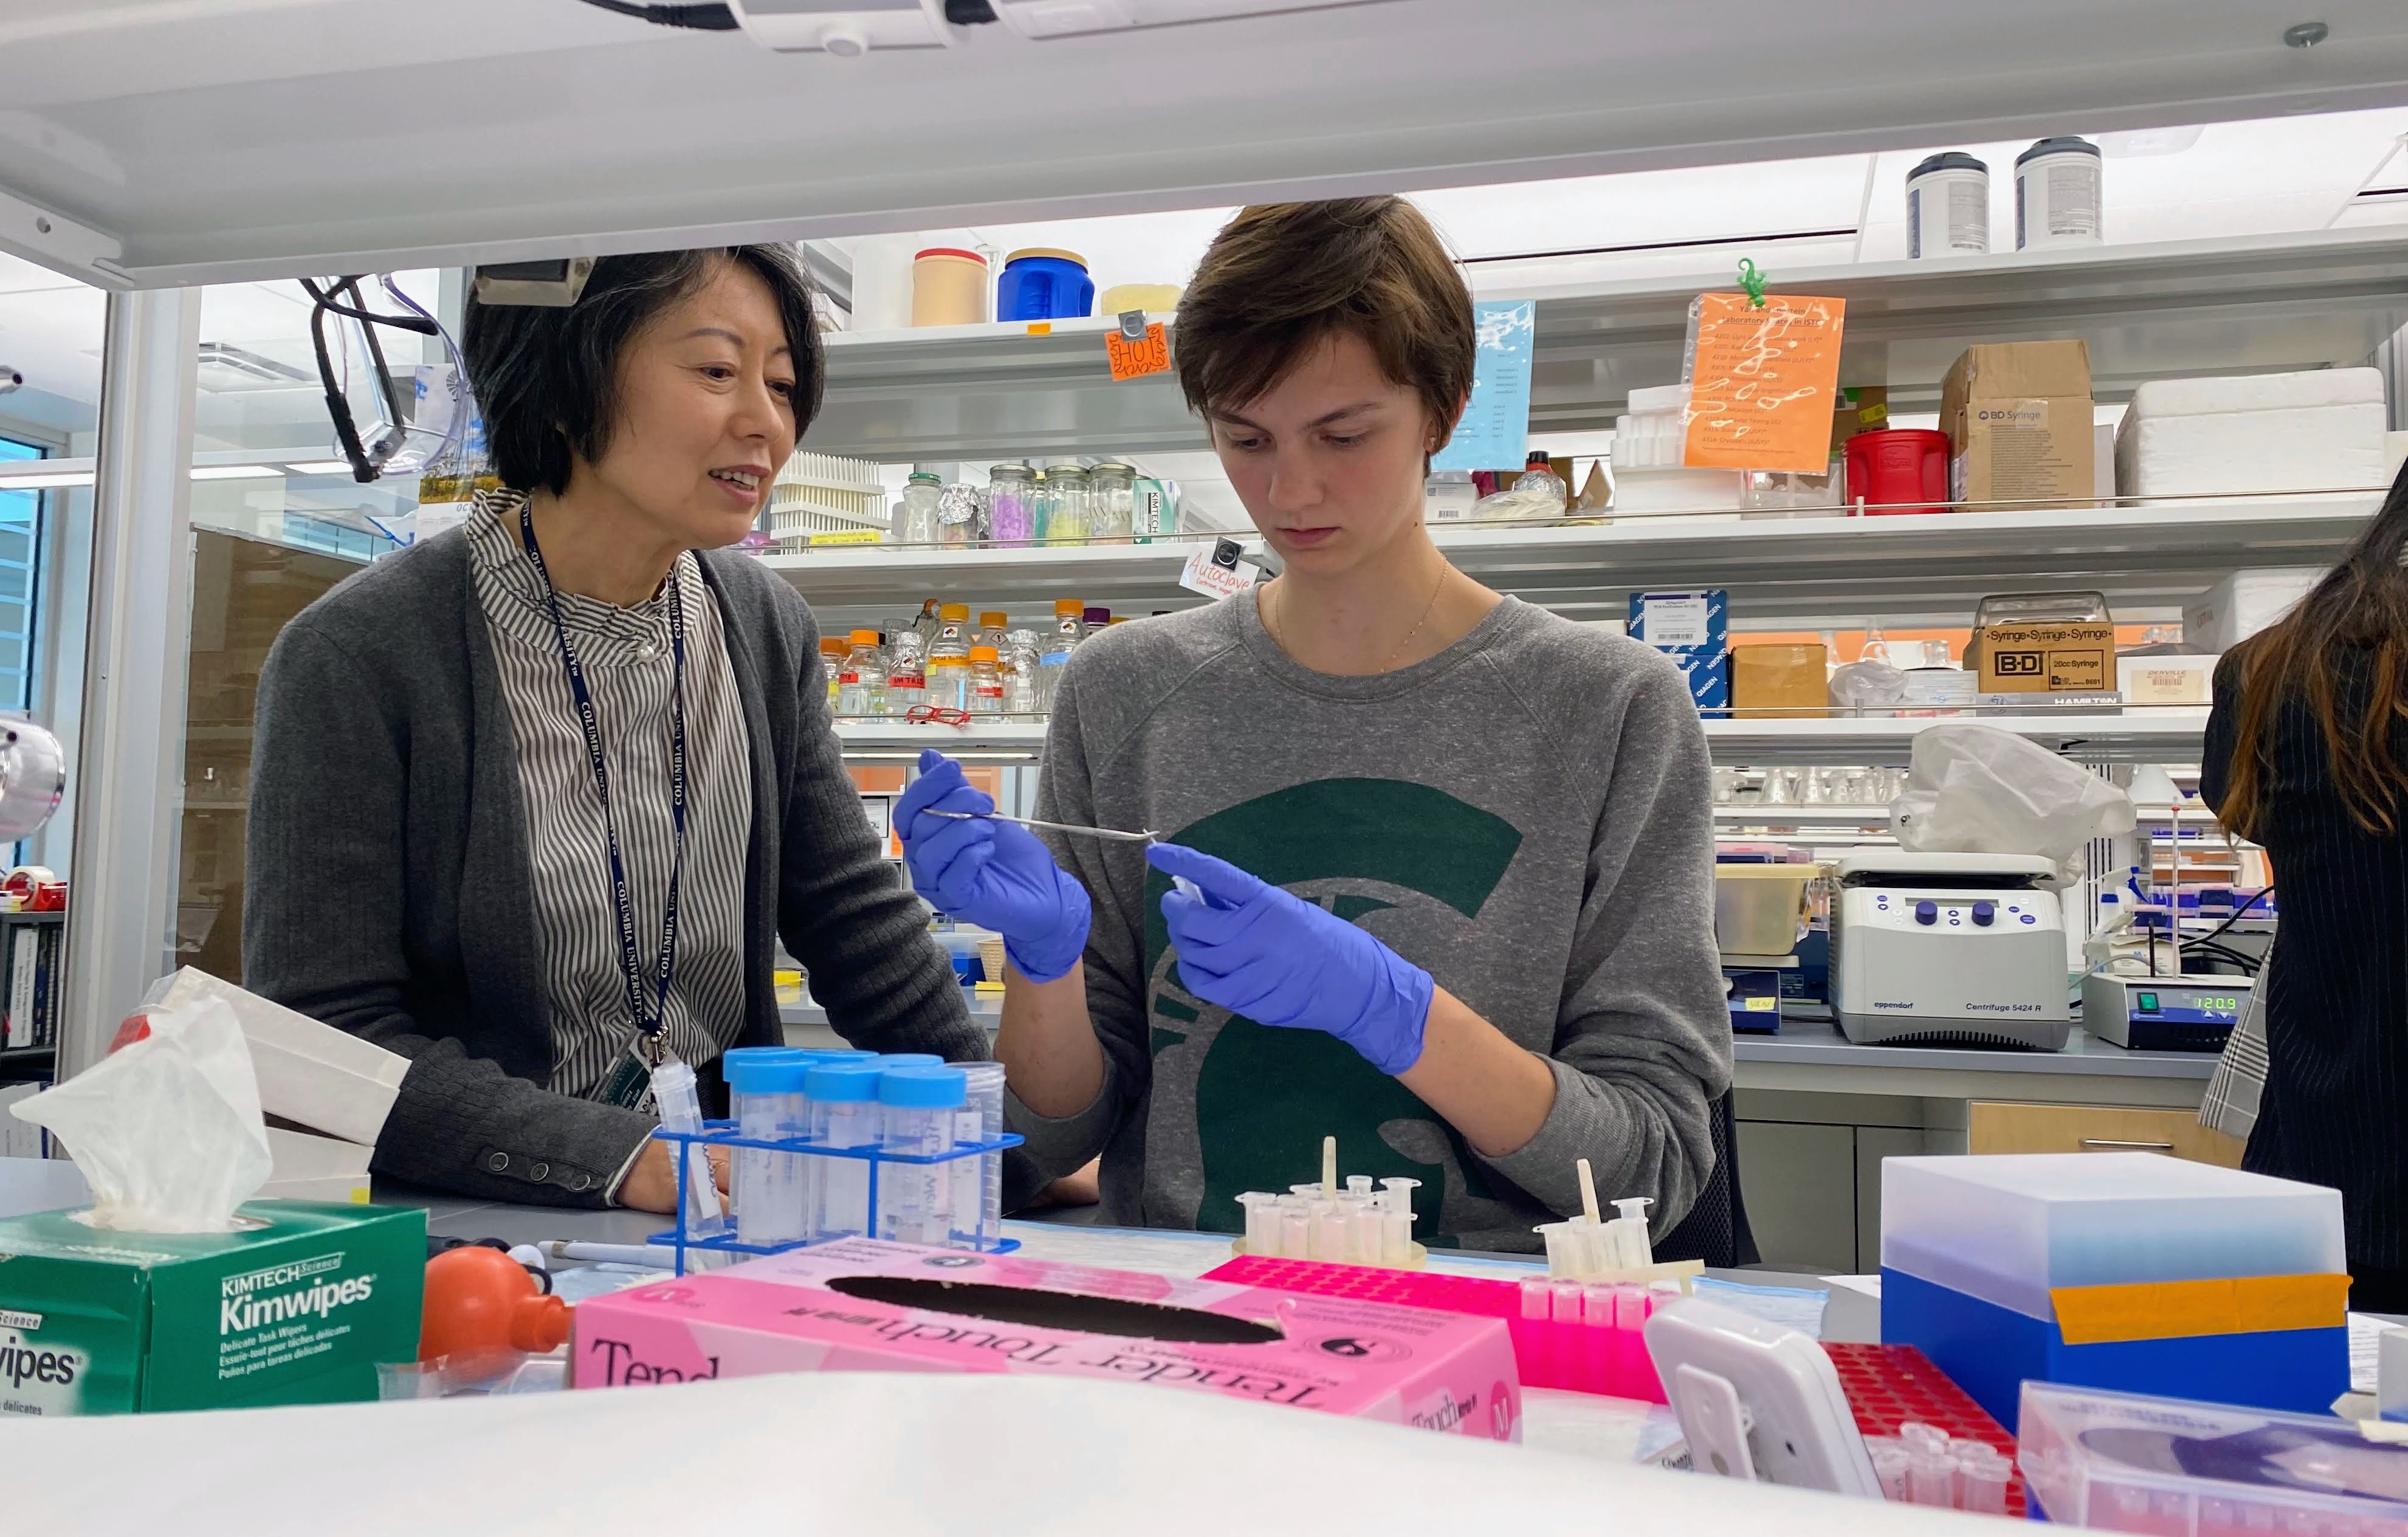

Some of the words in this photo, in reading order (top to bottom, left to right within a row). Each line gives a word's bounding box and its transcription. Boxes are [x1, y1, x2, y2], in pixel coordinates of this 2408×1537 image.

[1118, 335, 1156, 365] HOT
[1990, 411, 2005, 419] BD
[2007, 411, 2041, 421] Syringe
[1187, 552, 1250, 590] Autoclave
[1707, 603, 1721, 621] AGEN
[1990, 630, 2026, 642] Syringe
[2030, 630, 2067, 642] Syringe
[2071, 628, 2108, 641] Syringe
[907, 676, 924, 685] TRIS
[2071, 660, 2099, 669] Syringe
[1696, 676, 1718, 698] QIAGEN
[581, 701, 601, 765] COLUMBIA
[617, 881, 633, 943] COLUMBIA
[627, 946, 642, 1017] UNIVERSITY
[661, 915, 675, 978] COLUMBIA
[1966, 1003, 2011, 1012] Centrifuge
[2196, 997, 2236, 1009] 120.9
[222, 1265, 300, 1298] KIMTECH
[301, 1257, 340, 1273] Science
[220, 1277, 373, 1336] Kimwipes
[221, 1337, 256, 1354] Delicate
[258, 1330, 277, 1344] Task
[278, 1324, 308, 1338] Wipers
[873, 1318, 1066, 1366] Touch
[591, 1337, 721, 1389] Tend
[1079, 1353, 1329, 1409] Tender
[1492, 1397, 1510, 1439] M
